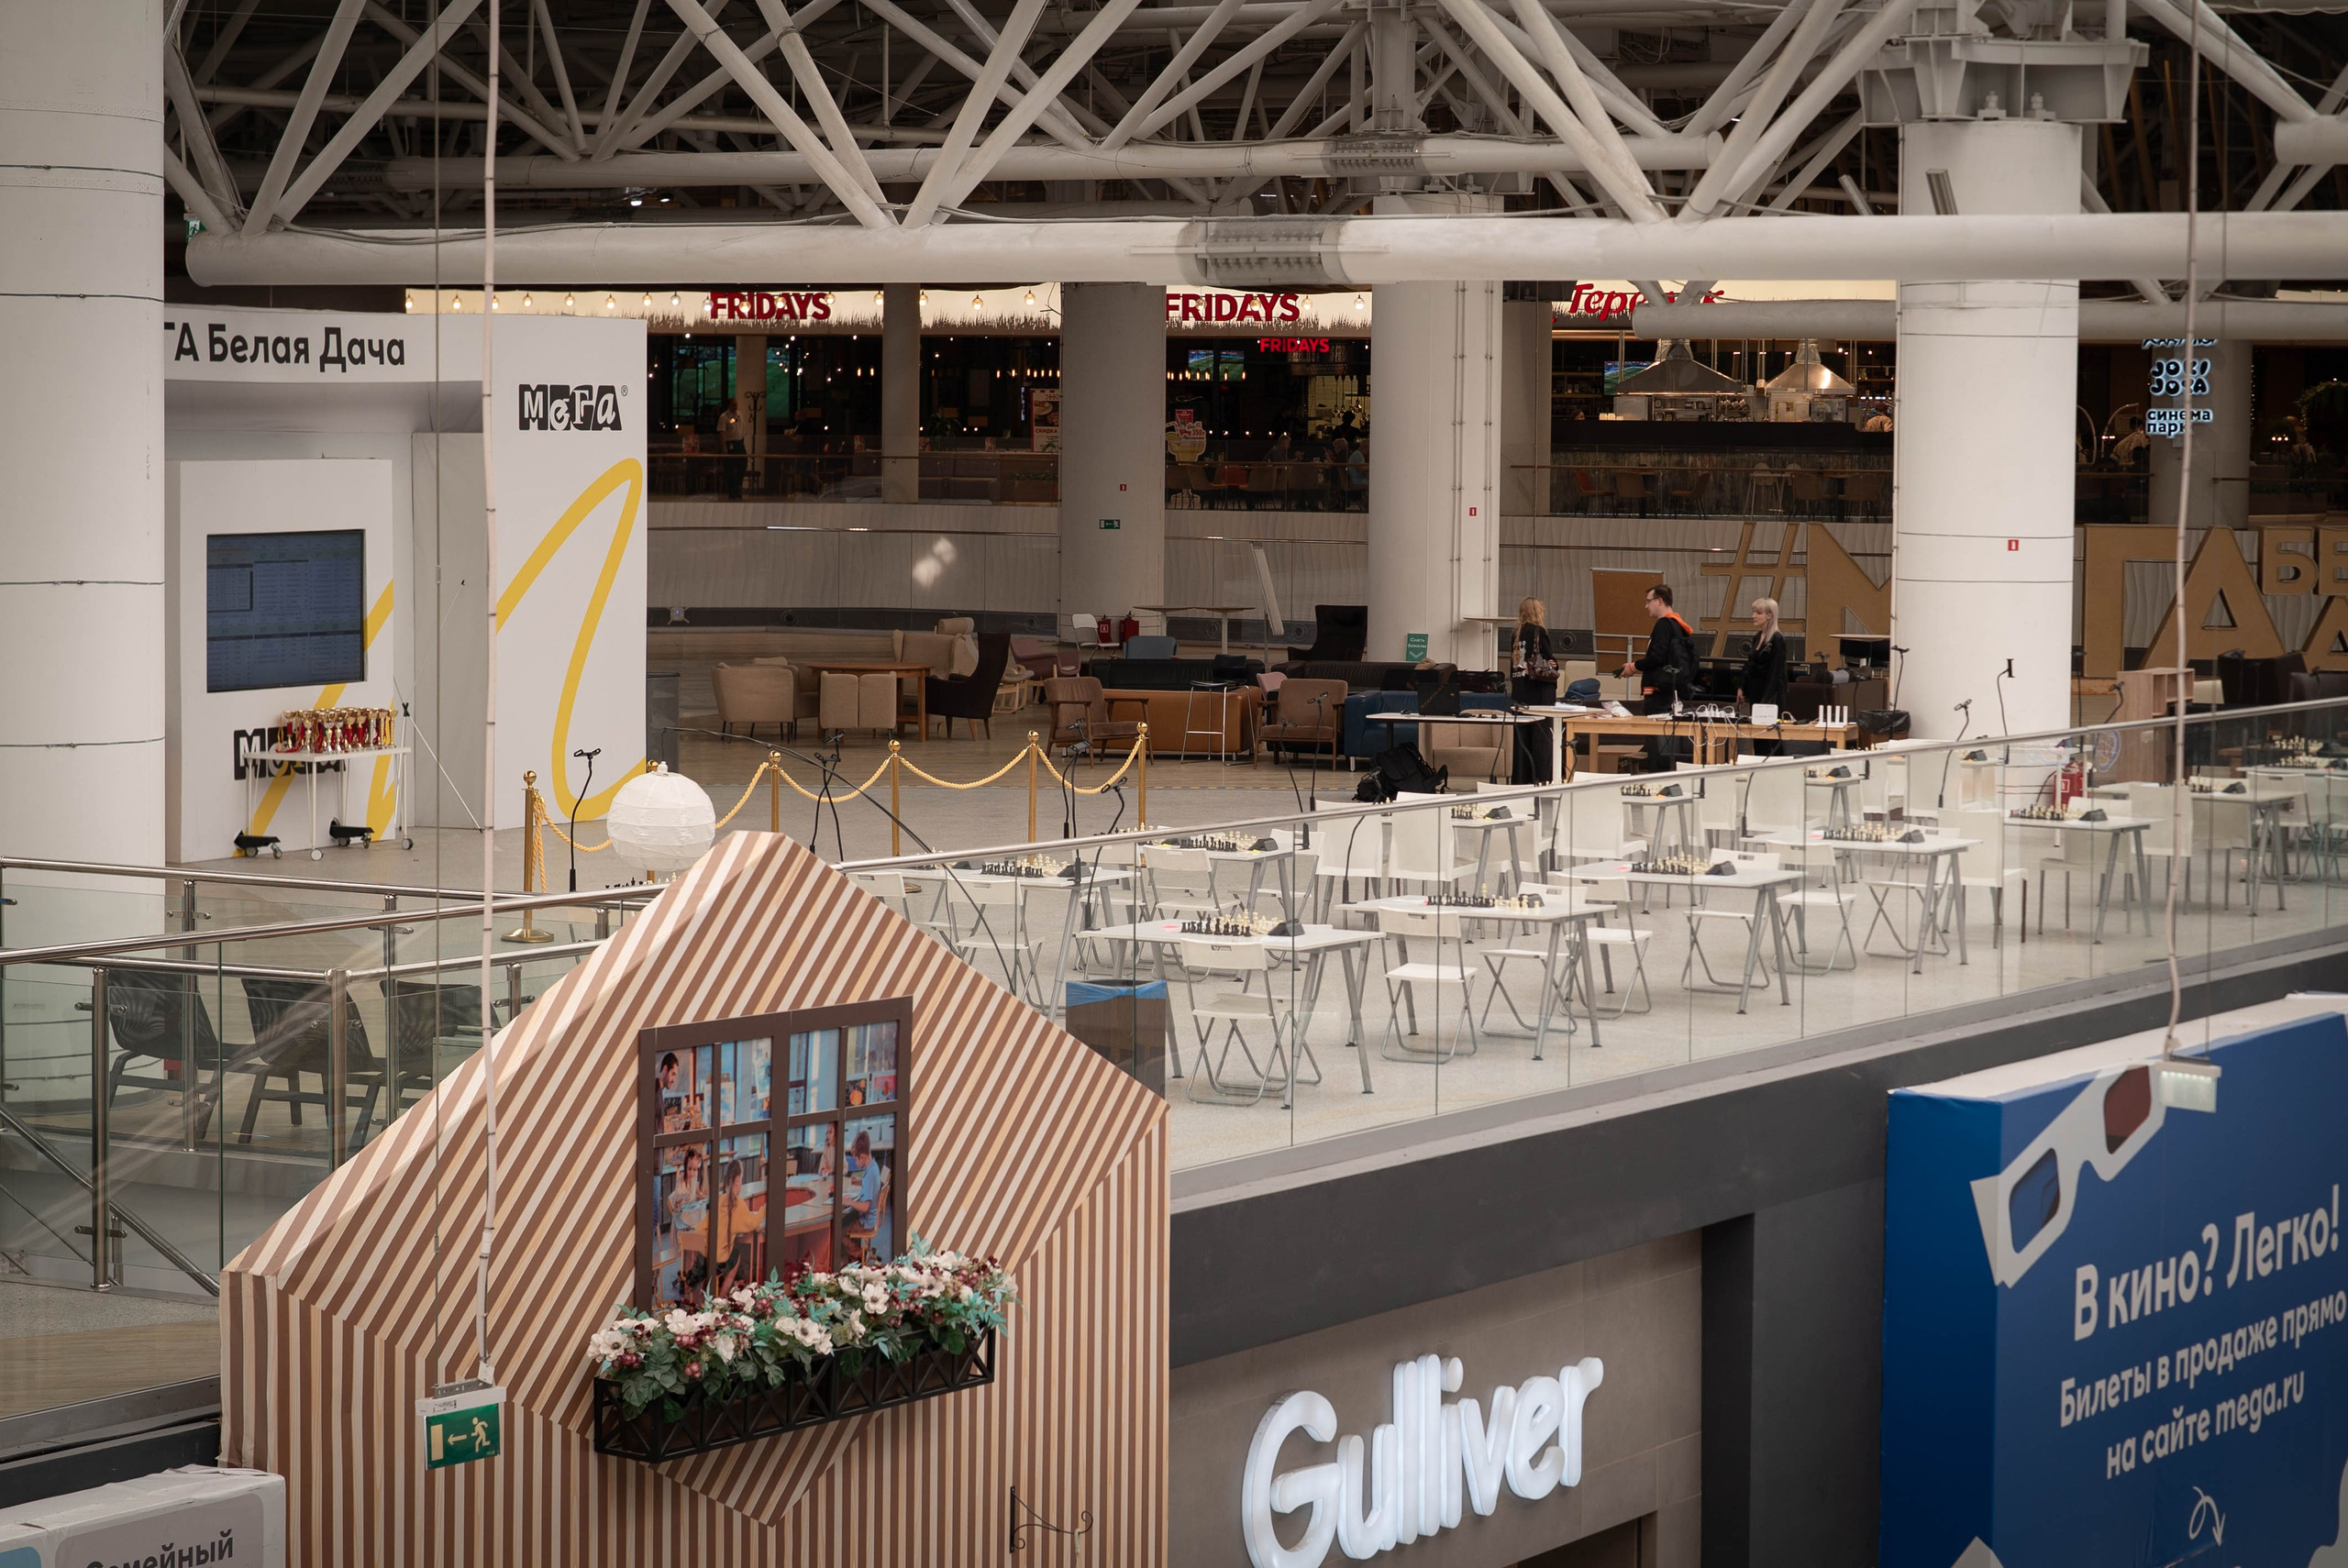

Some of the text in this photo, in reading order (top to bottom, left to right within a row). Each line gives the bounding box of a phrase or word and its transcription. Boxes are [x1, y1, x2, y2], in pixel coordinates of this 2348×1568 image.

[710, 292, 831, 320] FRIDAYS
[1166, 293, 1300, 321] FRIDAYS
[1260, 337, 1329, 353] FRIDAYS
[164, 322, 404, 373] А Белая Дача
[2074, 1184, 2340, 1342] В кино? Легко!
[2060, 1290, 2347, 1428] Билеты в продаже прямо
[1242, 1353, 1604, 1568] Gulliver
[2107, 1371, 2306, 1480] на сайте mega.ru
